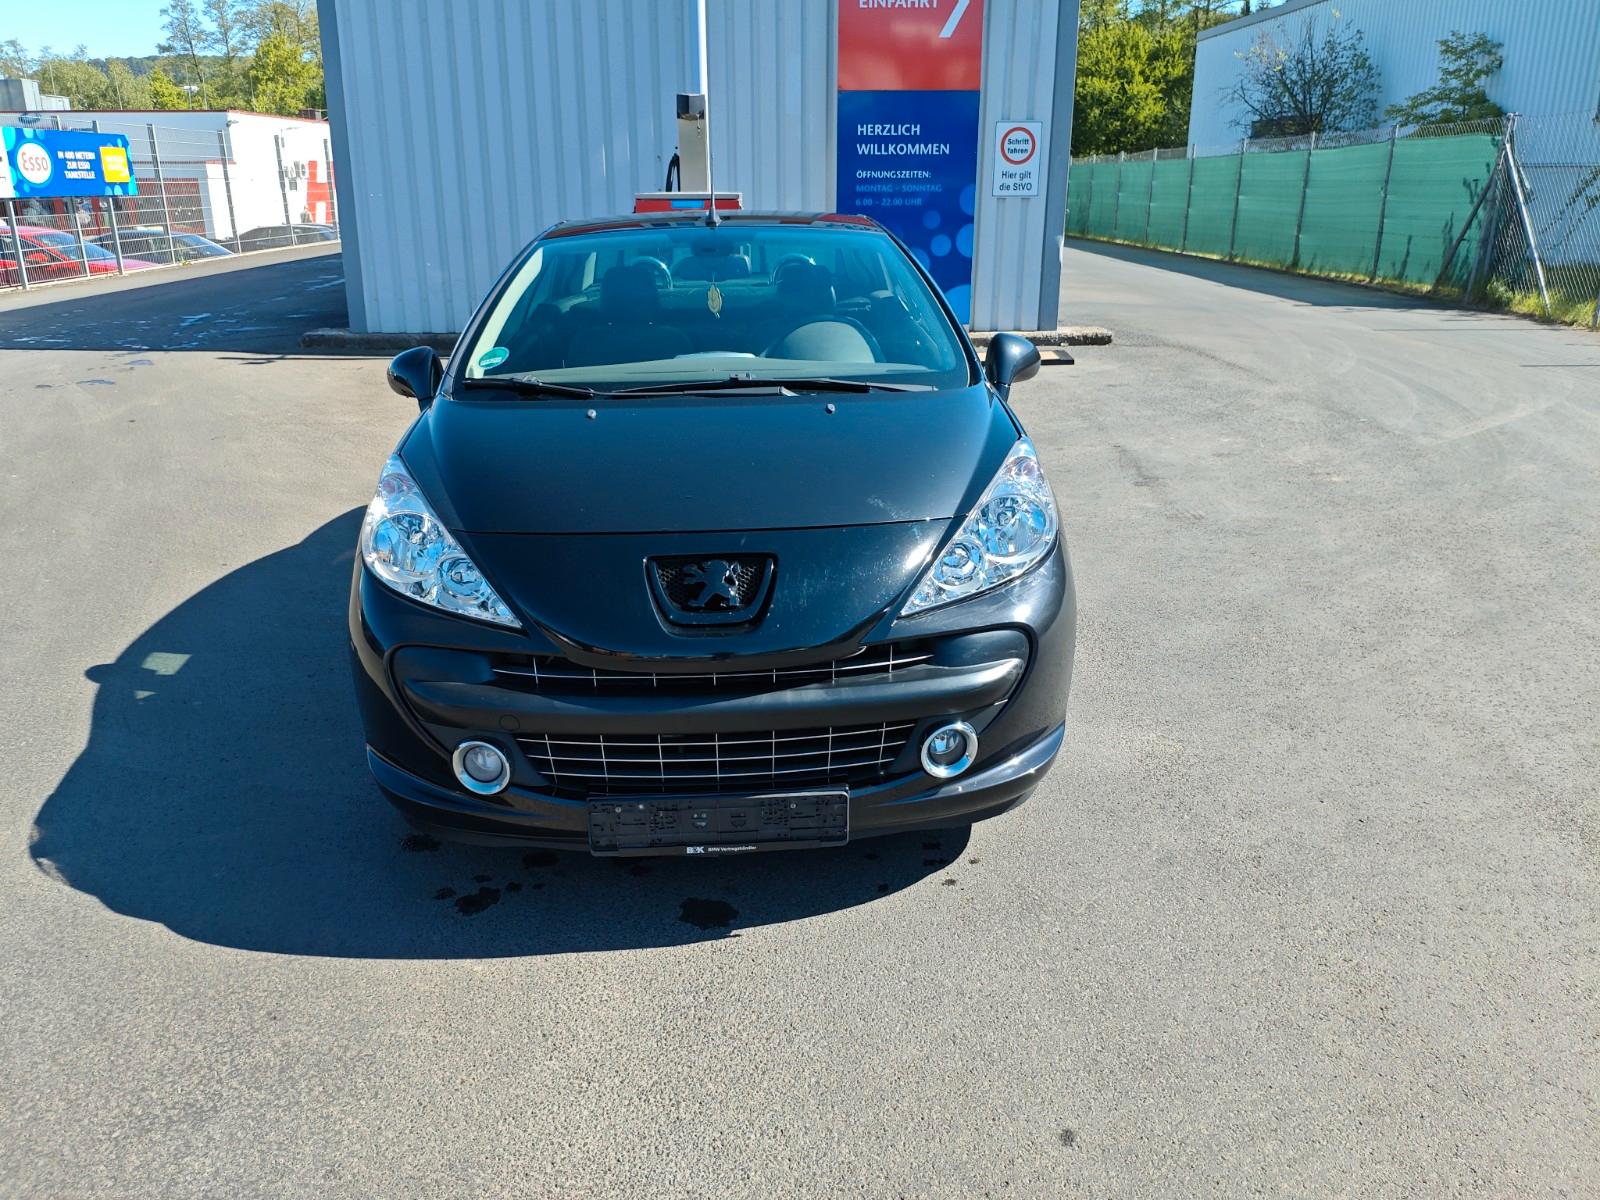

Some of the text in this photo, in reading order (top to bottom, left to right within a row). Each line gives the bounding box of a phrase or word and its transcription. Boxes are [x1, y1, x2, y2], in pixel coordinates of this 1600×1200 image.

[859, 0, 938, 8] EINFAHRT
[857, 124, 921, 136] HERZLICH
[856, 143, 951, 155] WILLKOMMEN
[856, 169, 932, 179] ÖFFNUNGSZEITEN:
[1001, 170, 1032, 181] Hier gilt
[855, 184, 893, 193] MONTAG
[901, 184, 943, 193] SONNTAG
[999, 182, 1033, 191] die StVO
[881, 198, 903, 206] 22.00
[904, 198, 923, 206] UHR
